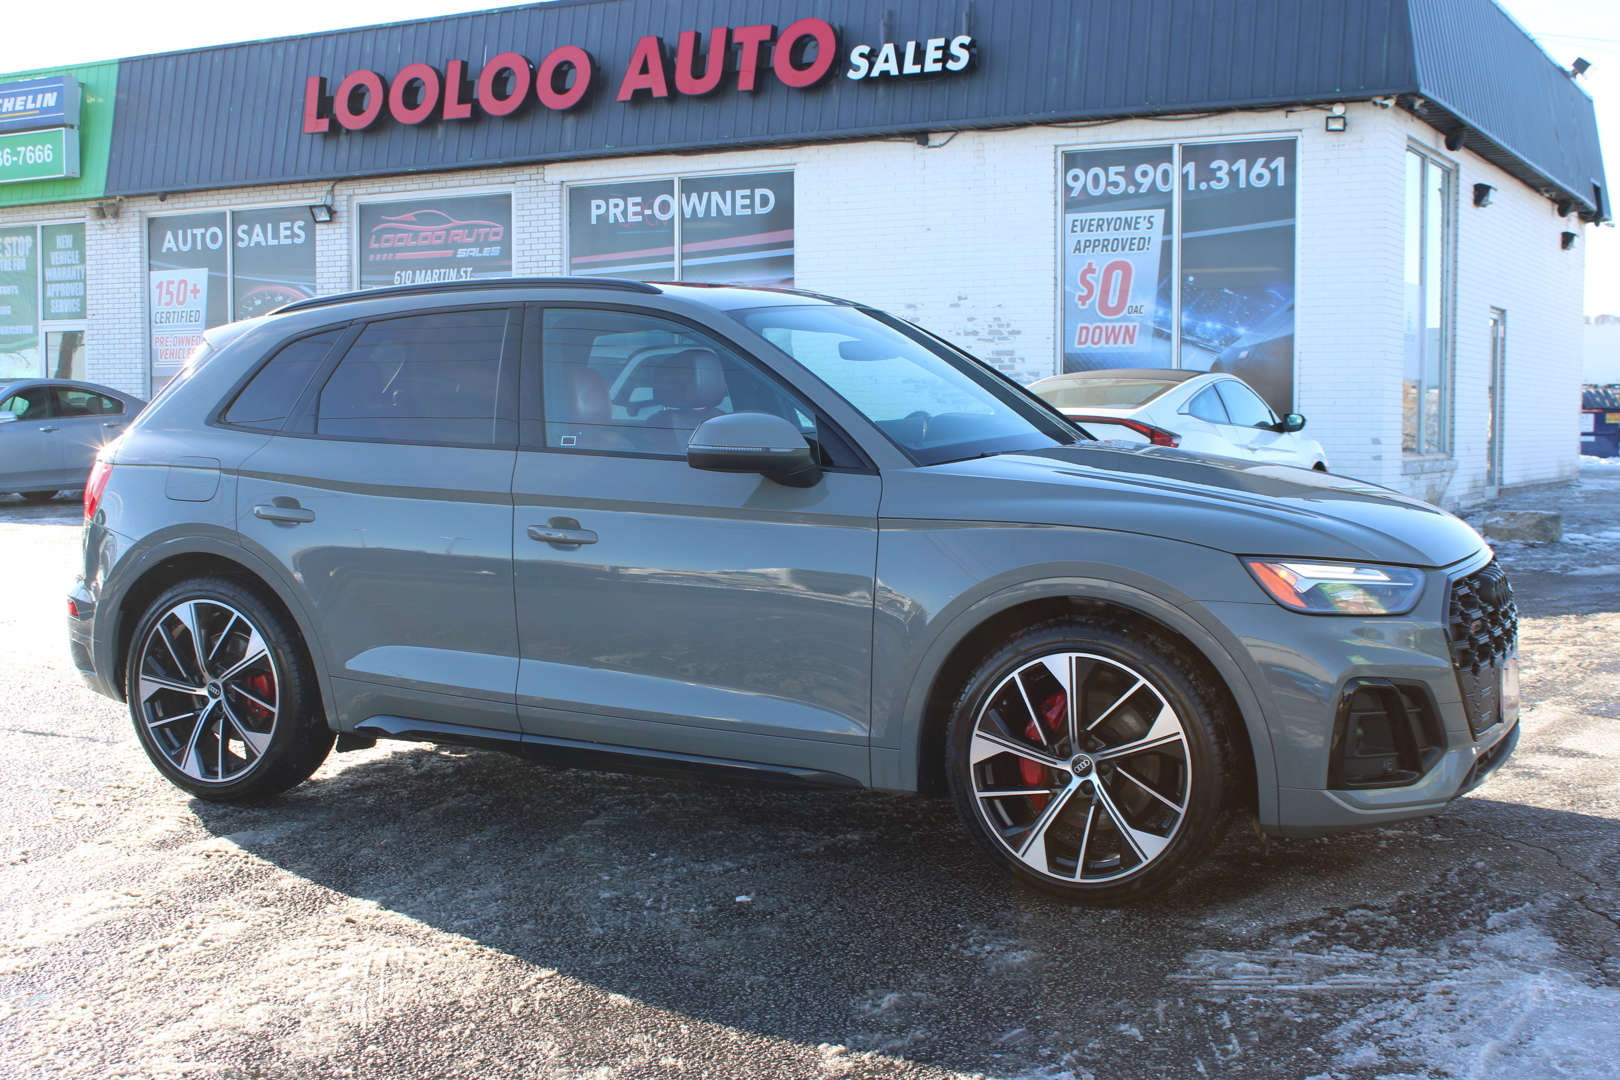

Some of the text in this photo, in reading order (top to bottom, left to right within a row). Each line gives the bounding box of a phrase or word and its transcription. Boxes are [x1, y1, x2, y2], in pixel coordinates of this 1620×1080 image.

[302, 17, 973, 134] LOOLOO AUTO SALES
[0, 91, 58, 113] HELIN
[1065, 156, 1285, 198] 905.901.3161
[590, 187, 776, 225] PRE-OWNED
[1070, 214, 1155, 234] EVERYONE'S
[4, 235, 32, 257] STOP
[56, 234, 73, 249] NEW
[161, 220, 306, 253] AUTO SALES
[369, 227, 504, 249] LOOLOO AUTO
[1072, 236, 1152, 255] APPROVED!
[50, 250, 80, 265] VEHICLE
[456, 246, 501, 258] SALES
[13, 257, 26, 271] FOR
[45, 266, 86, 281] WARRANTY
[394, 267, 474, 285] 610 MARTIN ST.
[46, 282, 85, 298] APPROVED
[155, 278, 201, 307] 150+
[1076, 259, 1144, 318] $0 OAC
[50, 298, 81, 313] SERVICE
[154, 309, 201, 324] CERTIFIED
[154, 335, 201, 347] PRE-OWNED
[1076, 324, 1137, 347] DOWN
